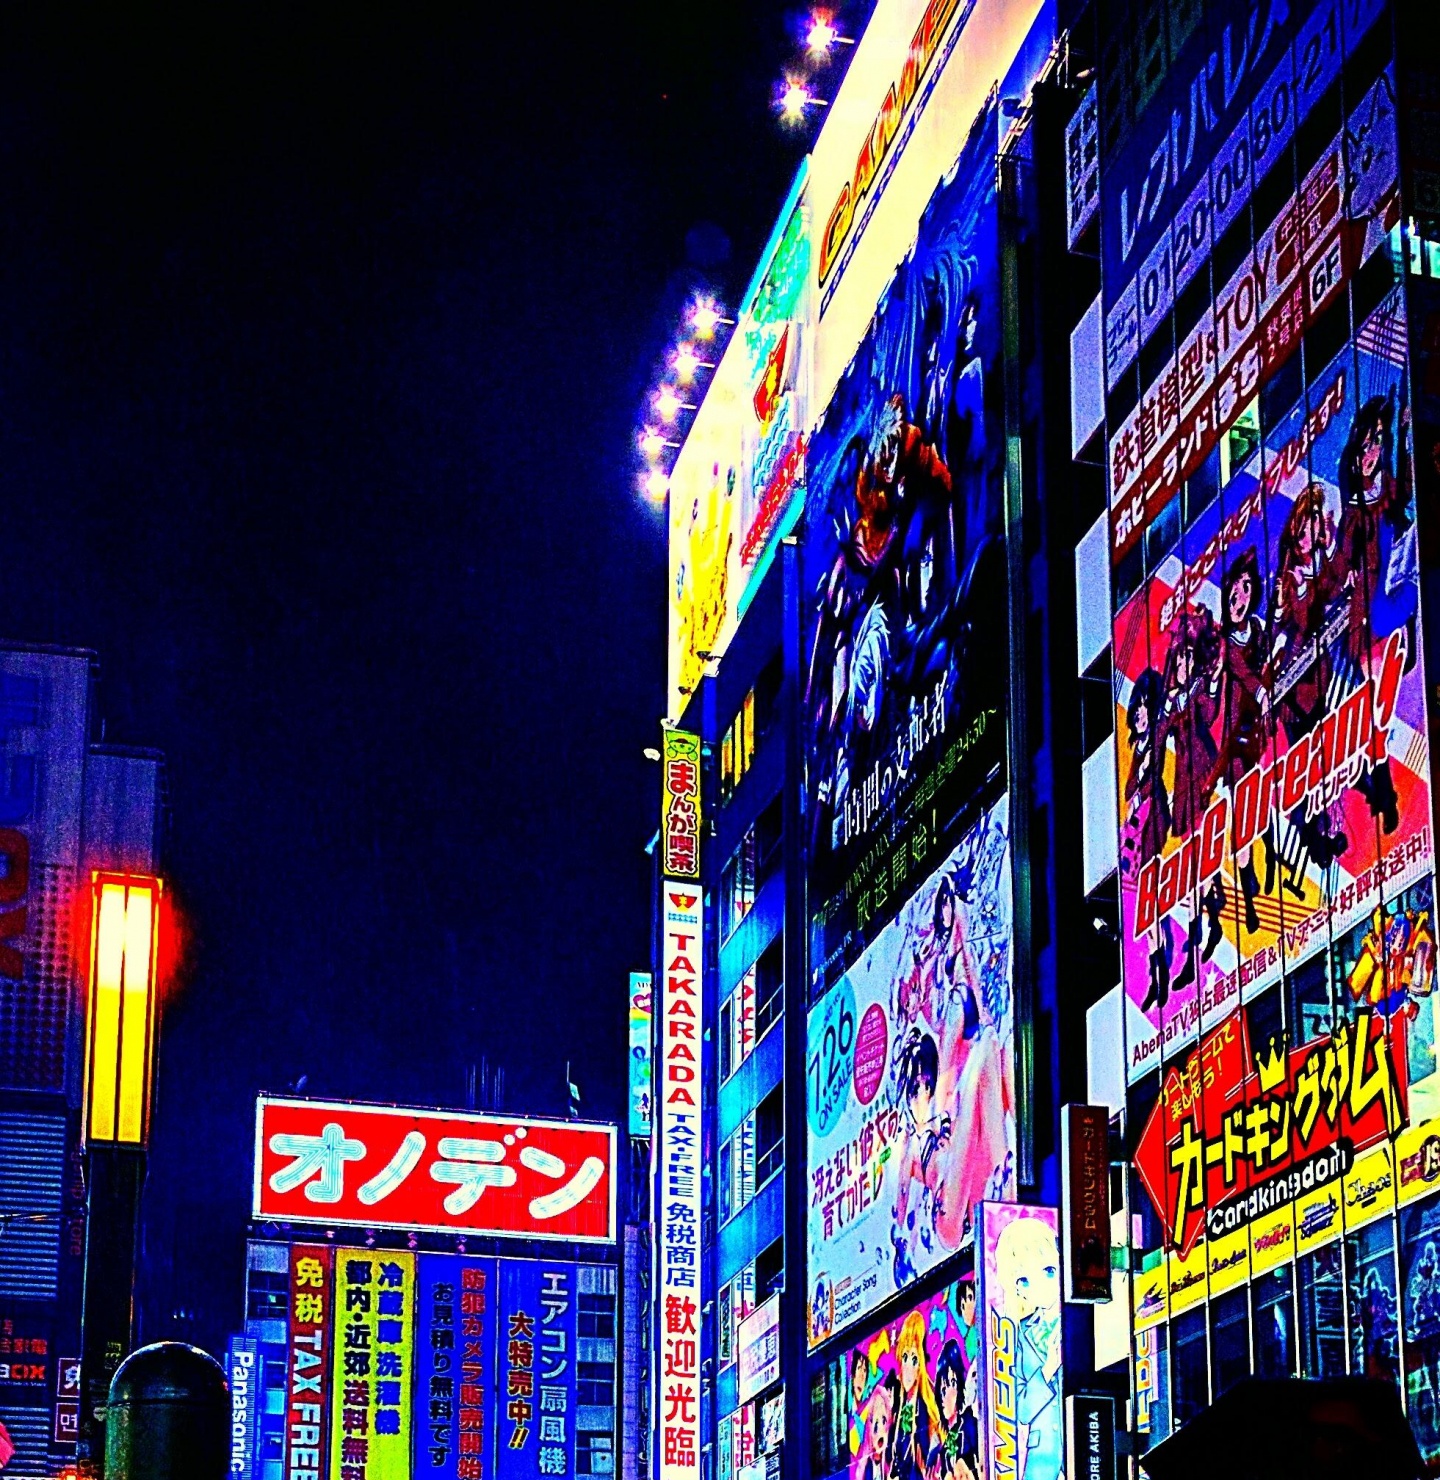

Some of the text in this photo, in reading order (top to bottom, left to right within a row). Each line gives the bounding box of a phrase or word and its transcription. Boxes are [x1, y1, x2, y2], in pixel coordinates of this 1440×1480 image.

[1312, 244, 1340, 302] 6F
[668, 761, 697, 873] まんが喫茶
[857, 809, 937, 932] 放送開始!
[667, 932, 697, 1107] TAKARADA
[808, 996, 854, 1115] 7.26
[818, 1059, 852, 1131] ON SALE
[1170, 1013, 1402, 1246] カードキングダム
[268, 1121, 606, 1220] オノデン
[296, 1256, 325, 1325] 免税
[666, 1201, 698, 1288] 免税商店
[230, 1351, 254, 1473] Panasonic
[292, 1329, 323, 1395] TAX
[665, 1293, 698, 1468] 歓迎光臨
[1089, 1411, 1100, 1453] AKIBA
